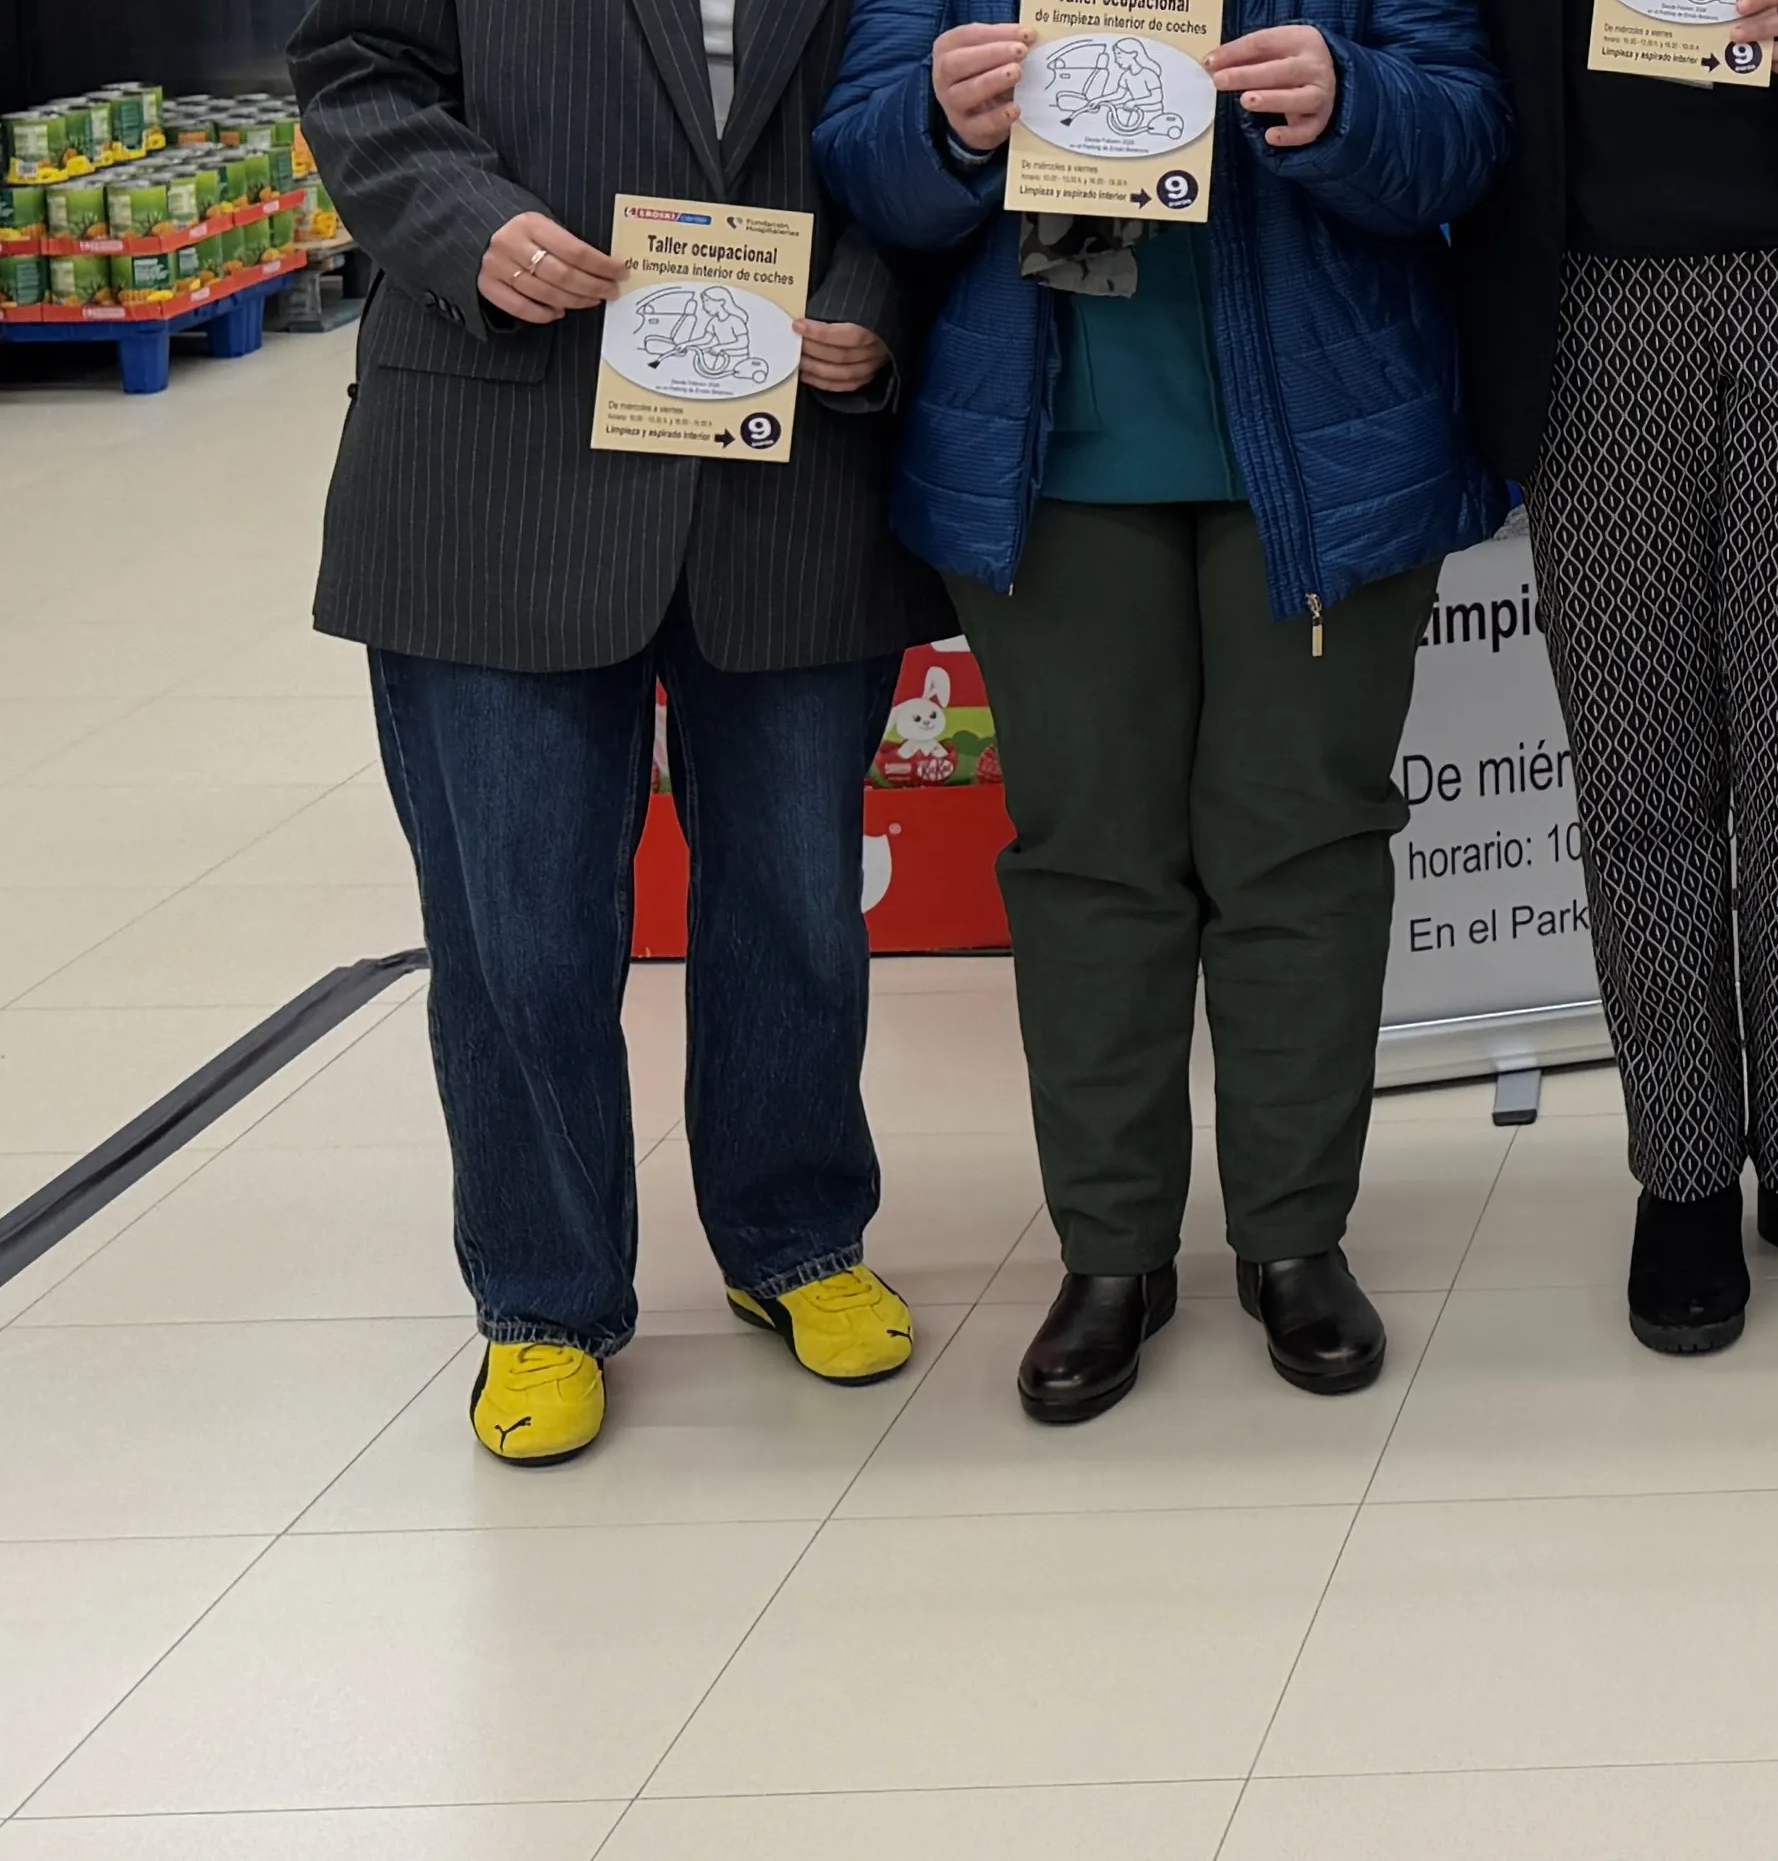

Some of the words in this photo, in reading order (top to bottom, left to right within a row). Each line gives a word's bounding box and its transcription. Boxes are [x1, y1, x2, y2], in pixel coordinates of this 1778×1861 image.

[1034, 8, 1049, 22] de
[1051, 9, 1100, 28] limpieza
[1103, 14, 1144, 29] interior
[1148, 18, 1162, 31] de
[1165, 19, 1207, 34] coches
[1730, 41, 1754, 65] 9
[1163, 175, 1189, 199] 9
[646, 234, 688, 255] Taller
[690, 239, 776, 267] ocupacional
[624, 257, 639, 270] de
[641, 258, 689, 277] limpieza
[692, 263, 732, 279] interior
[735, 268, 750, 281] de
[753, 270, 793, 285] coches
[747, 416, 773, 440] 9
[1403, 753, 1462, 806] De
[1409, 830, 1532, 881] horario:
[1410, 917, 1454, 953] En
[1469, 908, 1497, 945] el
